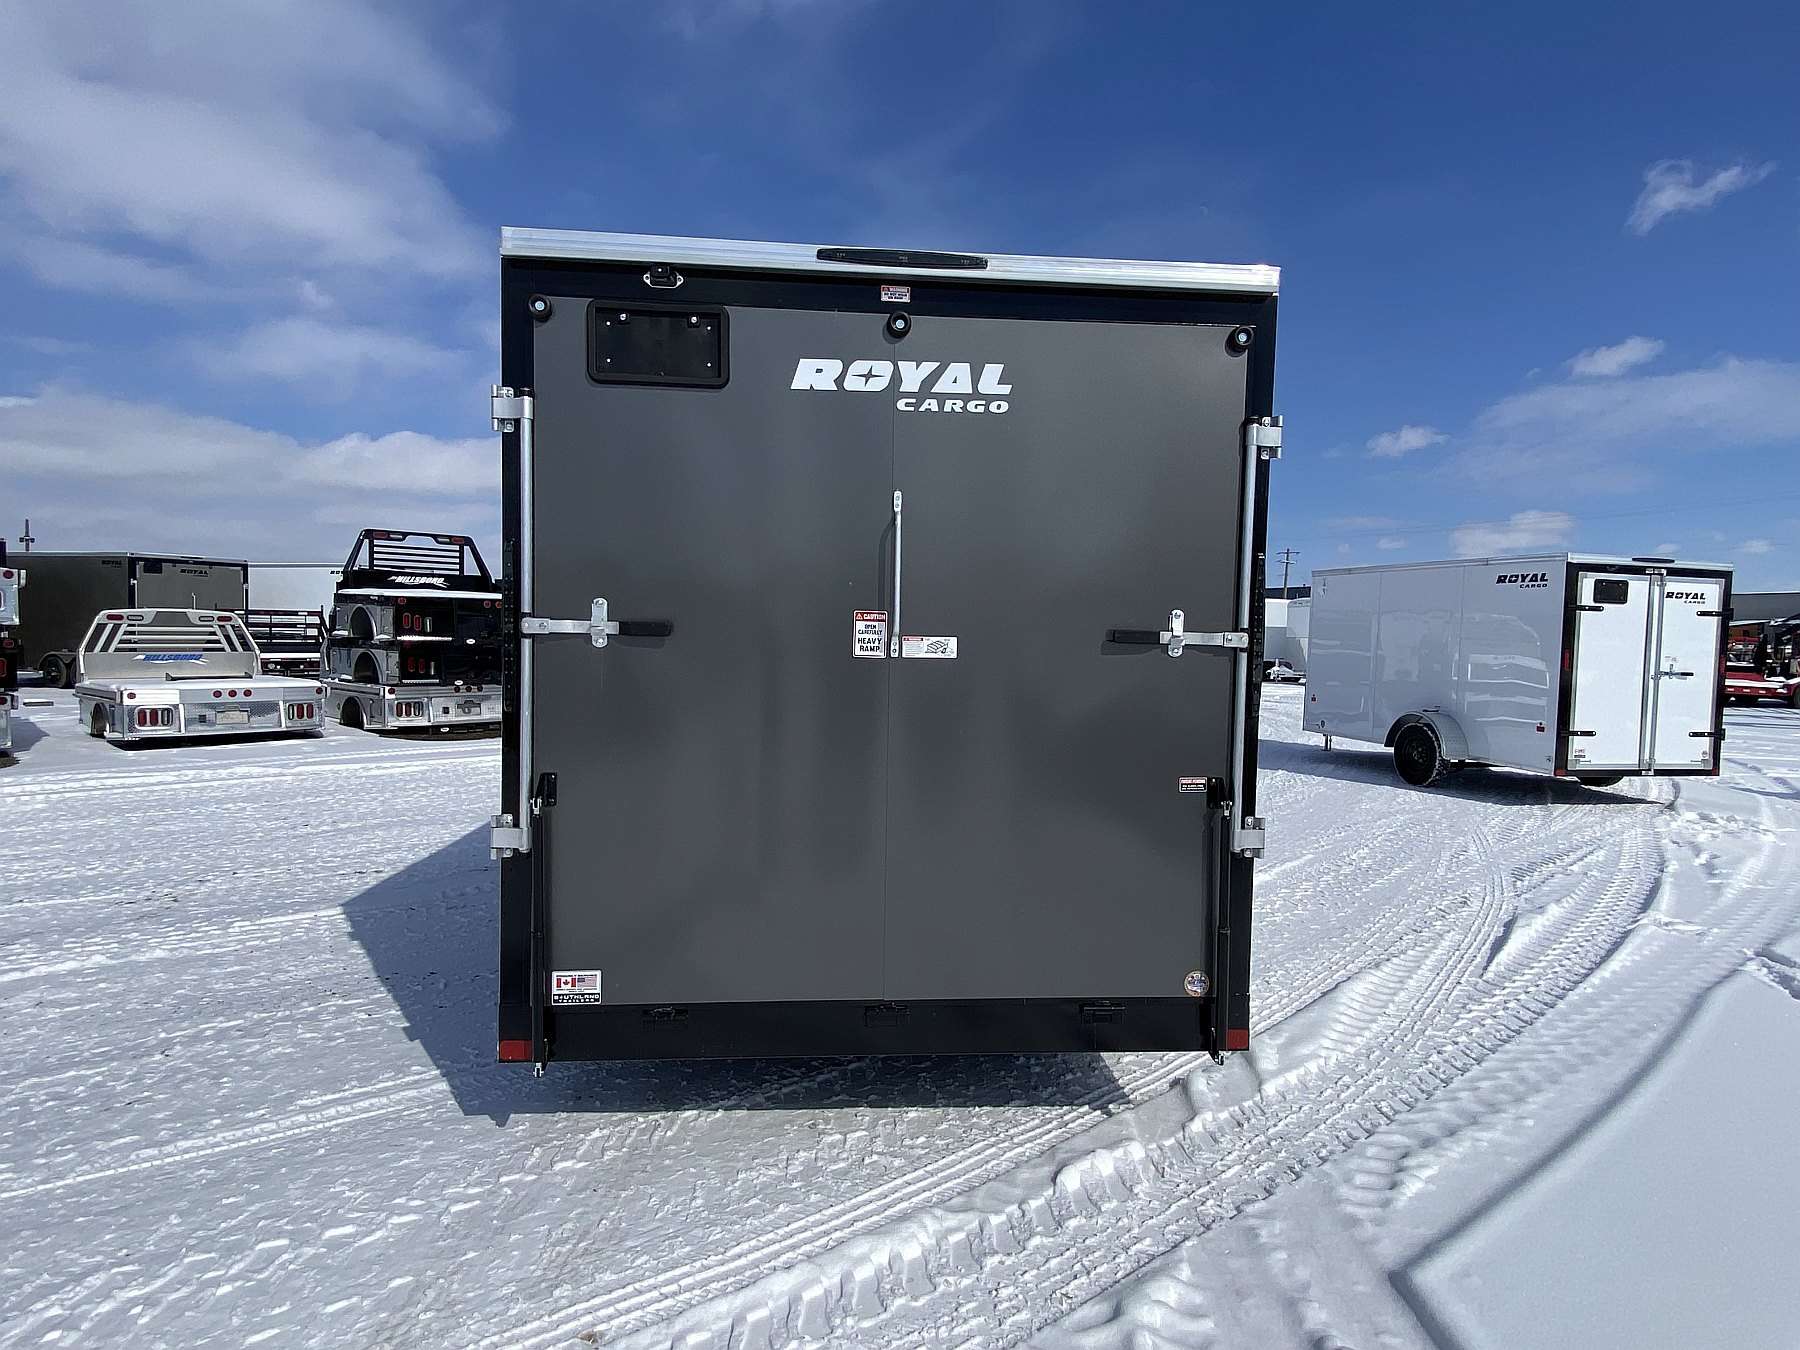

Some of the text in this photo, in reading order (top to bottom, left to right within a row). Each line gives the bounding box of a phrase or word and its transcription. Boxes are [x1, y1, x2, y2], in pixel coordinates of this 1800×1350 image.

[790, 358, 1013, 395] ROYAL
[896, 398, 1009, 413] CARGO
[394, 576, 445, 584] HILLSBORO
[1495, 572, 1549, 584] ROYAL
[1665, 592, 1706, 600] ROYAL
